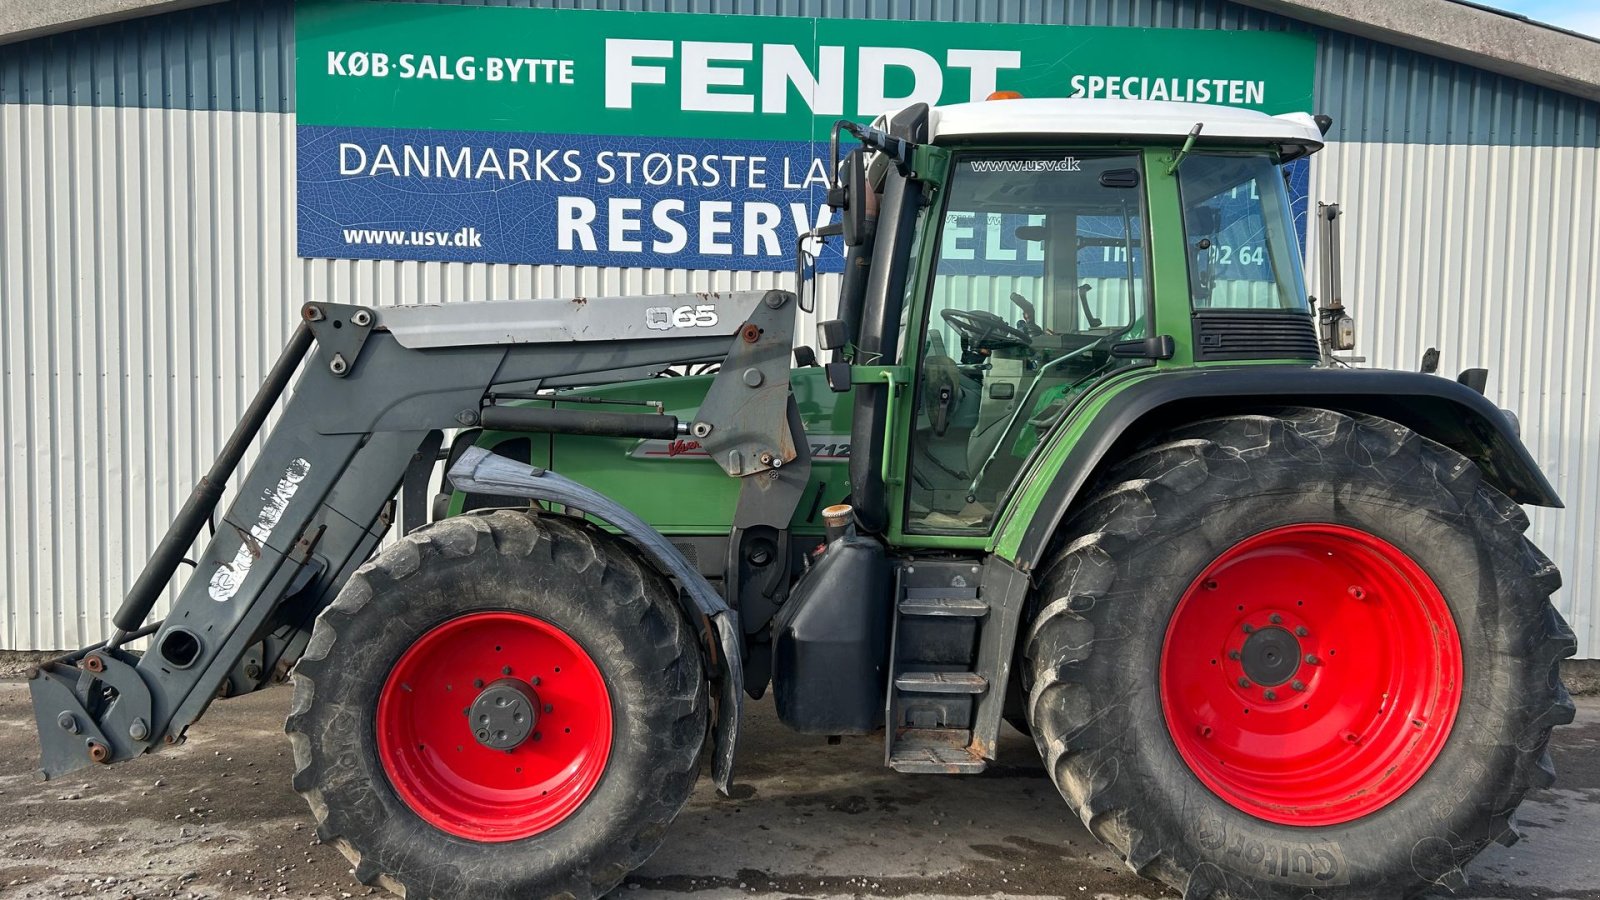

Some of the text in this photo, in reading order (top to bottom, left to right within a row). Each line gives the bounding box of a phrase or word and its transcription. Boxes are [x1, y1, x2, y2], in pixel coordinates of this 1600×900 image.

[605, 38, 1021, 116] FENDT
[1070, 74, 1265, 105] SPECIALISTEN
[339, 142, 582, 183] DANMARKS
[597, 151, 766, 188] STØRSTE
[971, 157, 1081, 173] www.usv.dk
[342, 227, 482, 249] www.usv.dk
[1239, 246, 1264, 266] 64
[646, 304, 719, 332] Q65
[1225, 834, 1339, 881] Cultor
